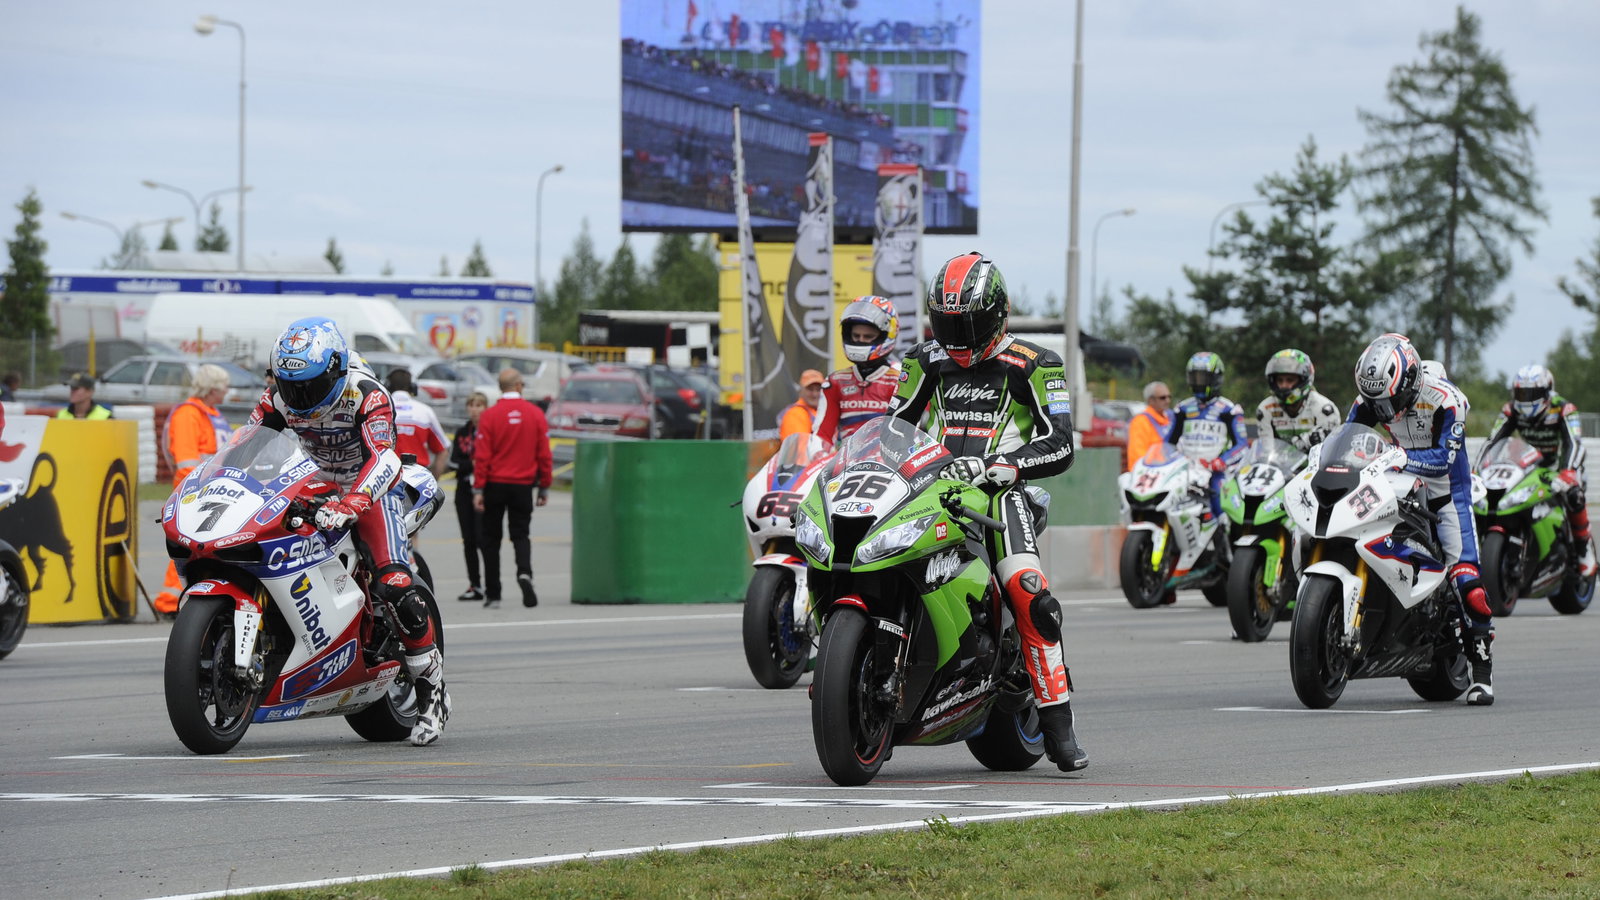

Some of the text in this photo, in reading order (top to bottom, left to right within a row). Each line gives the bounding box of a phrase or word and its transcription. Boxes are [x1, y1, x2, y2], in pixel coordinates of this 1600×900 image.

[936, 304, 969, 312] SHARK
[279, 358, 307, 368] X-lite
[1359, 377, 1386, 389] NOLAN
[944, 382, 998, 404] Ninja
[839, 400, 890, 409] HONDA
[945, 427, 994, 437] Motocard
[1193, 423, 1221, 433] FIXI
[320, 432, 352, 446] TIM
[1017, 443, 1071, 469] Kawasaki
[223, 469, 242, 478] TIM
[1422, 462, 1448, 470] Motorrad
[1244, 468, 1275, 485] 44
[197, 485, 245, 500] Unibat
[833, 474, 892, 502] 66
[270, 497, 286, 512] TIM
[756, 493, 804, 519] 65
[836, 502, 858, 512] elf
[1347, 485, 1380, 520] 33
[197, 502, 228, 532] 7
[898, 506, 935, 520] Kawasaki
[1010, 491, 1034, 552] Kawasaki
[216, 534, 254, 547] SAPAL
[925, 549, 961, 584] Ninja
[289, 573, 332, 651] Unibat
[240, 614, 253, 654] PIRELLI
[878, 620, 905, 636] PIRELLI
[317, 645, 350, 680] TIM
[376, 664, 400, 679] DUCATI
[921, 674, 993, 722] Kawasaki
